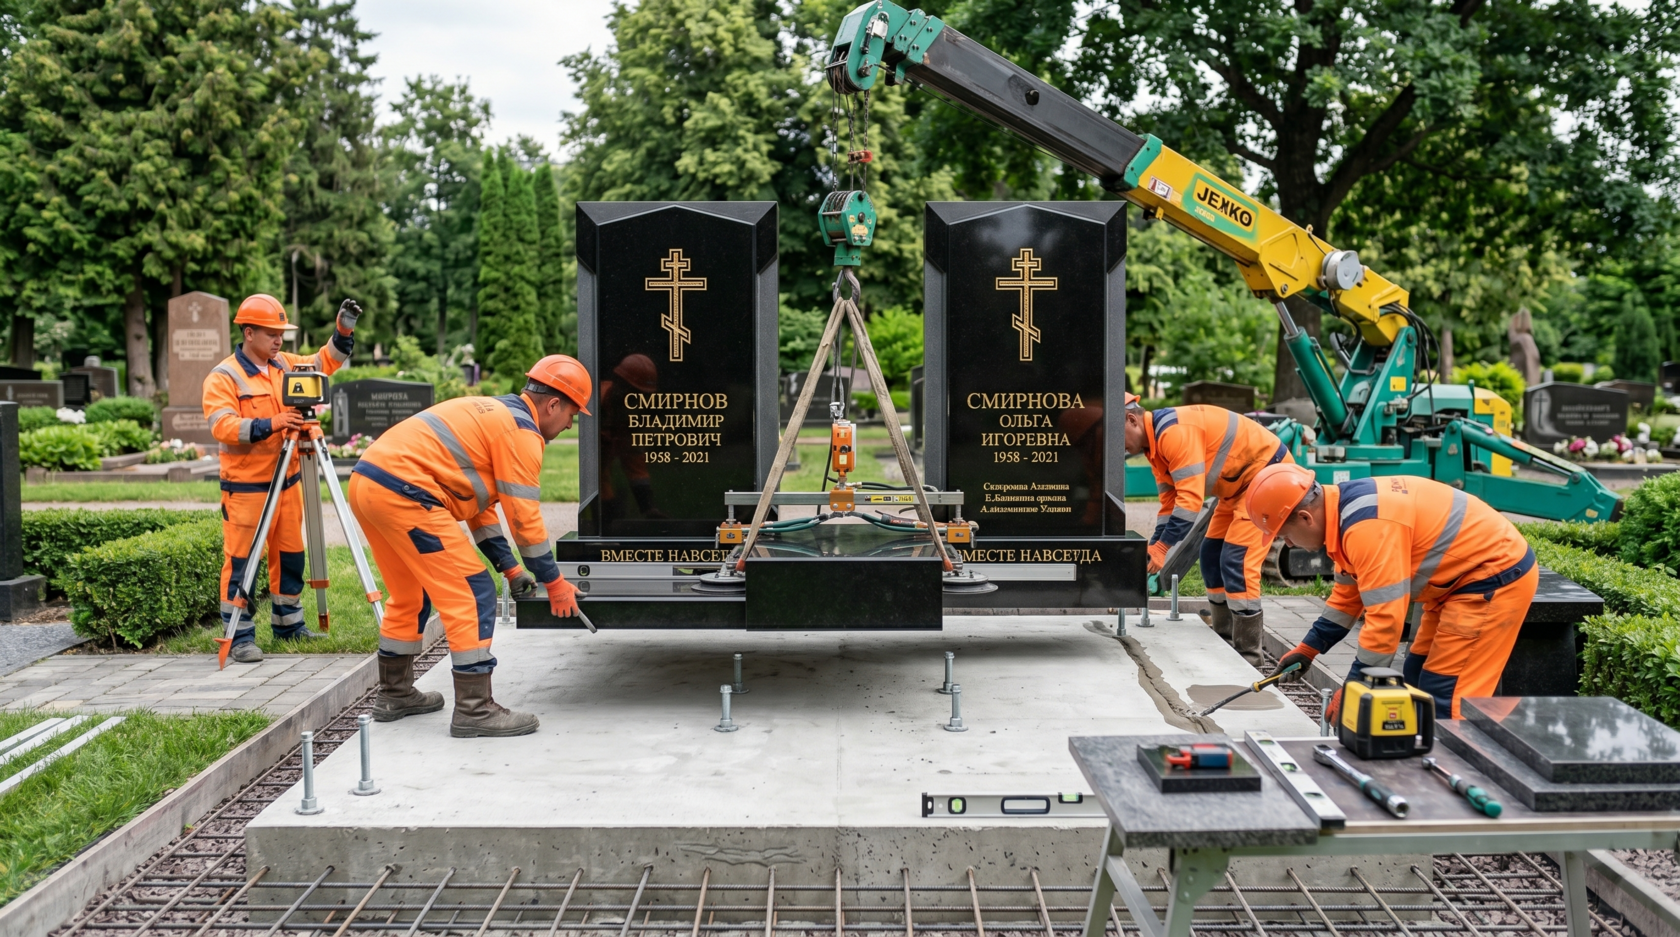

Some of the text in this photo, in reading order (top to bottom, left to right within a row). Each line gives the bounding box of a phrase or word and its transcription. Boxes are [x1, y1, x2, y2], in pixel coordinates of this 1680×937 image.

[624, 392, 728, 410] СМИРНОВ
[966, 392, 1086, 410] СМИРНОВА
[999, 414, 1053, 428] ОЛЬГА
[631, 432, 722, 447] ПЕТРОВИЧ
[981, 432, 1072, 447] ИГОРЕВНА
[644, 451, 671, 463] 1958
[682, 451, 710, 463] 2021
[994, 451, 1021, 463] 1958
[1031, 451, 1059, 463] 2021
[601, 549, 664, 562] ВМЕСТЕ
[956, 549, 1016, 562] МЕСТЕ
